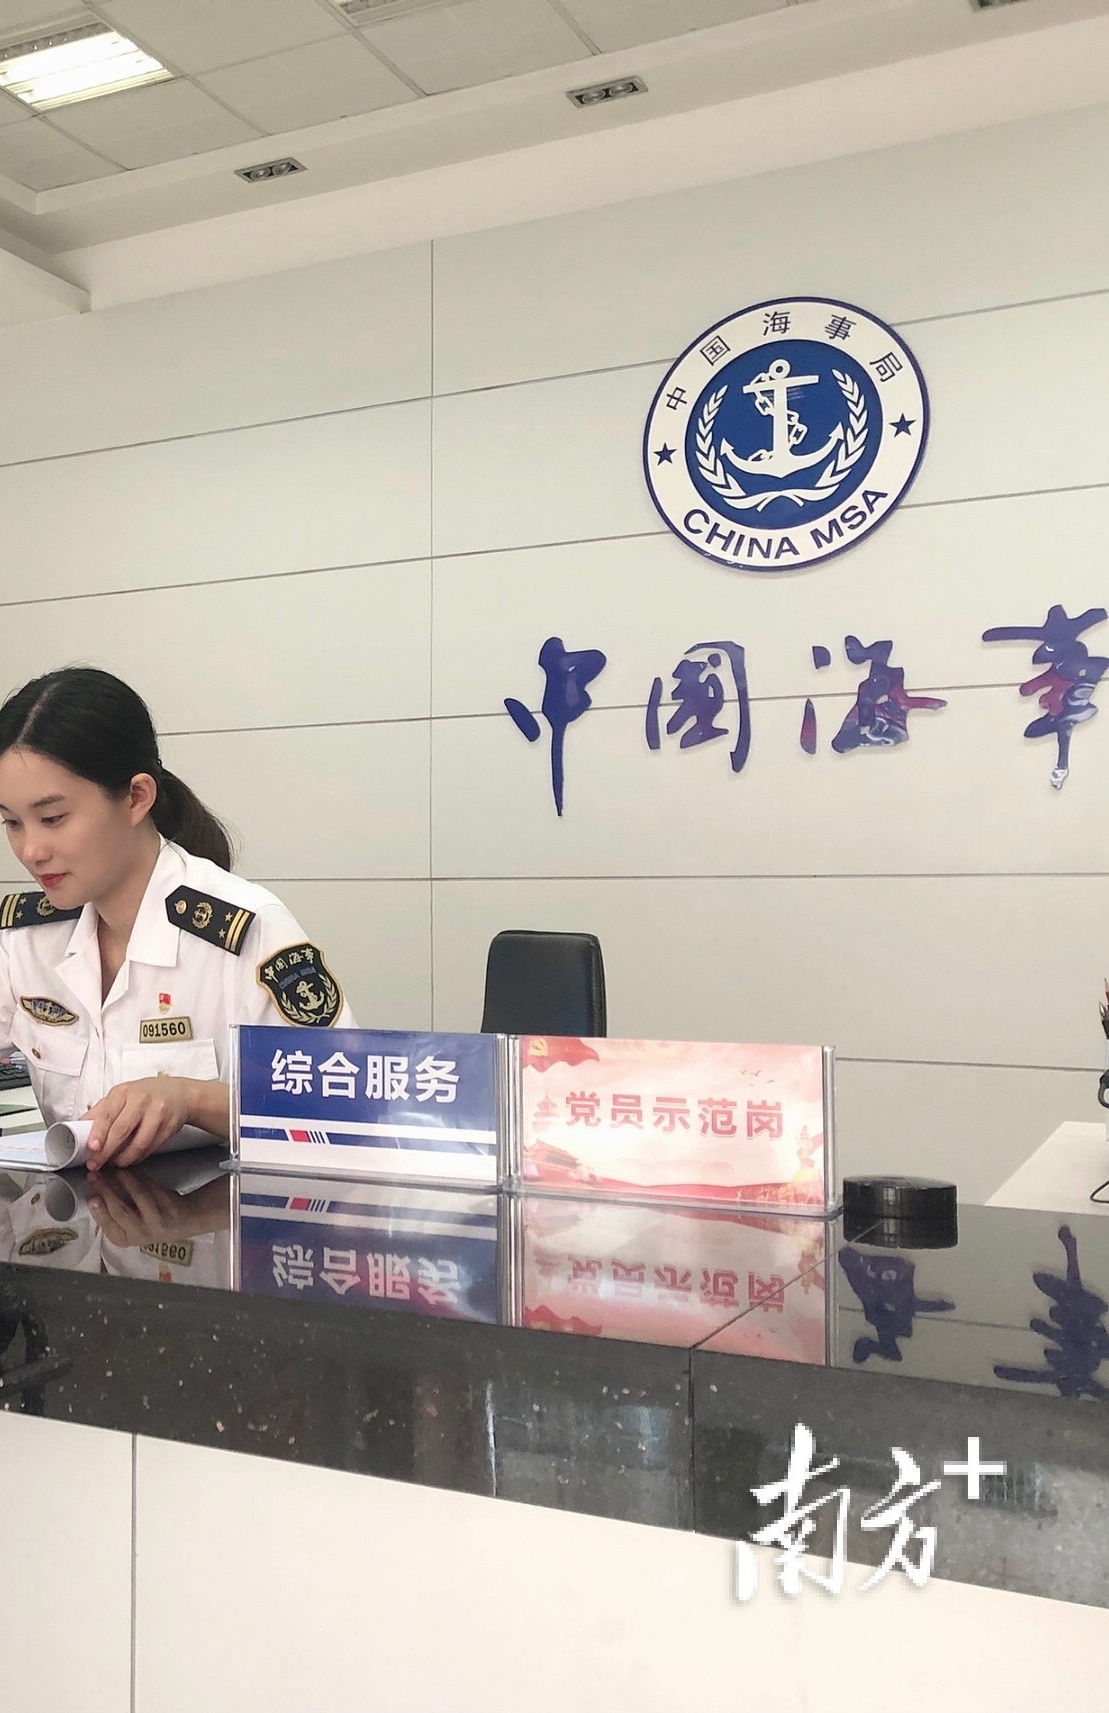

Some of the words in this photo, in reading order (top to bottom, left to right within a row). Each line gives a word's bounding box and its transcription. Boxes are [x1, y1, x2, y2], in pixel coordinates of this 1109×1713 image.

[665, 311, 903, 412] 中国海事局
[683, 508, 800, 560] CHINA
[810, 488, 889, 549] MSA
[142, 1022, 187, 1040] 091560
[270, 1048, 461, 1104] 综合服务
[564, 1090, 785, 1141] 党员示范岗
